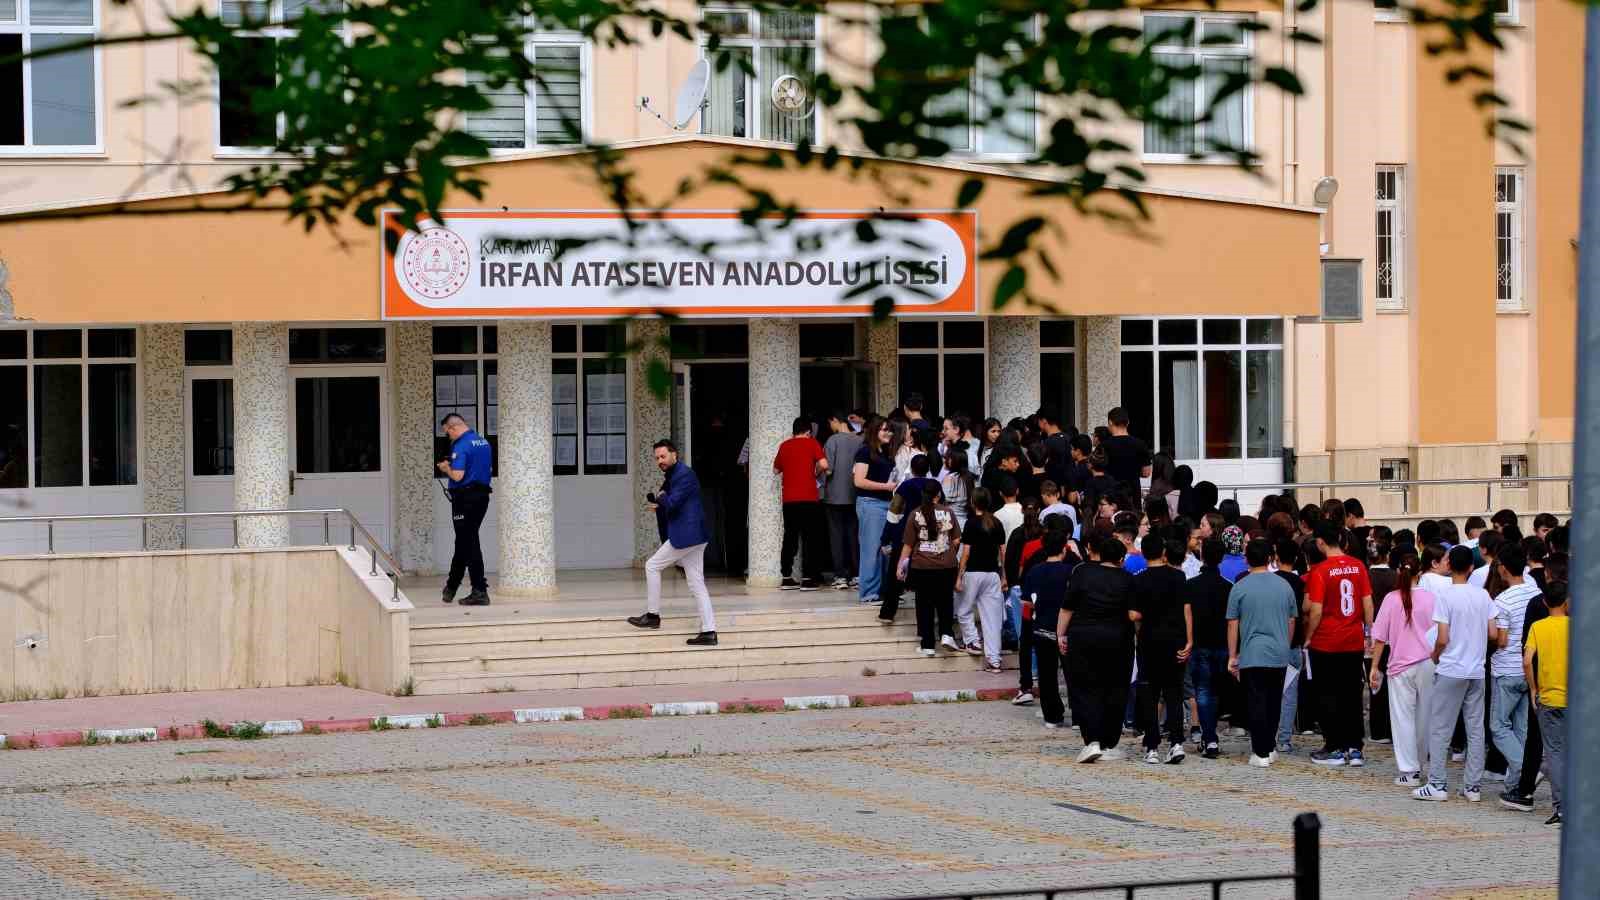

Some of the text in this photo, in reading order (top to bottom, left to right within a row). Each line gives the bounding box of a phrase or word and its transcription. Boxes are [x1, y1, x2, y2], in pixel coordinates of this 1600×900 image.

[480, 256, 563, 287] İRFAN
[572, 261, 715, 287] ATASEVEN
[723, 261, 861, 286] ANADOLU
[870, 255, 948, 285] LİSESİ
[1340, 579, 1354, 616] 8
